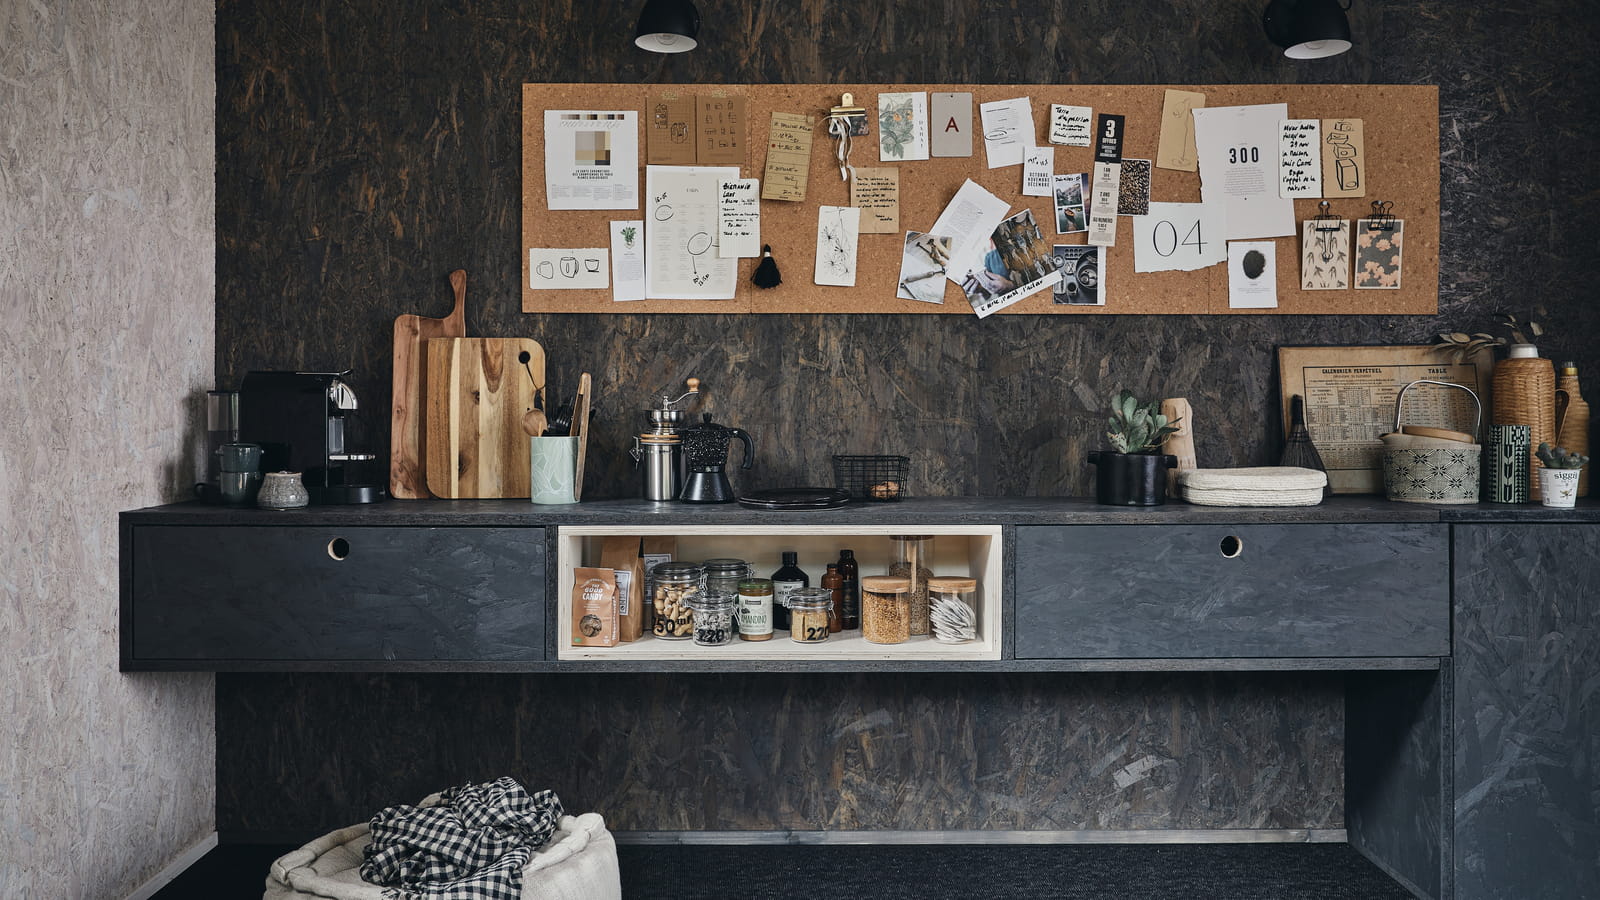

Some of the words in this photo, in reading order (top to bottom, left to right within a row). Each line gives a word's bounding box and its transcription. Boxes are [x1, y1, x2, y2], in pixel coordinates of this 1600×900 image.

[944, 116, 960, 133] A
[1105, 119, 1116, 138] 3
[1229, 147, 1259, 164] 300
[1153, 219, 1208, 257] 04
[582, 593, 604, 601] CANDY
[807, 626, 830, 641] 220
